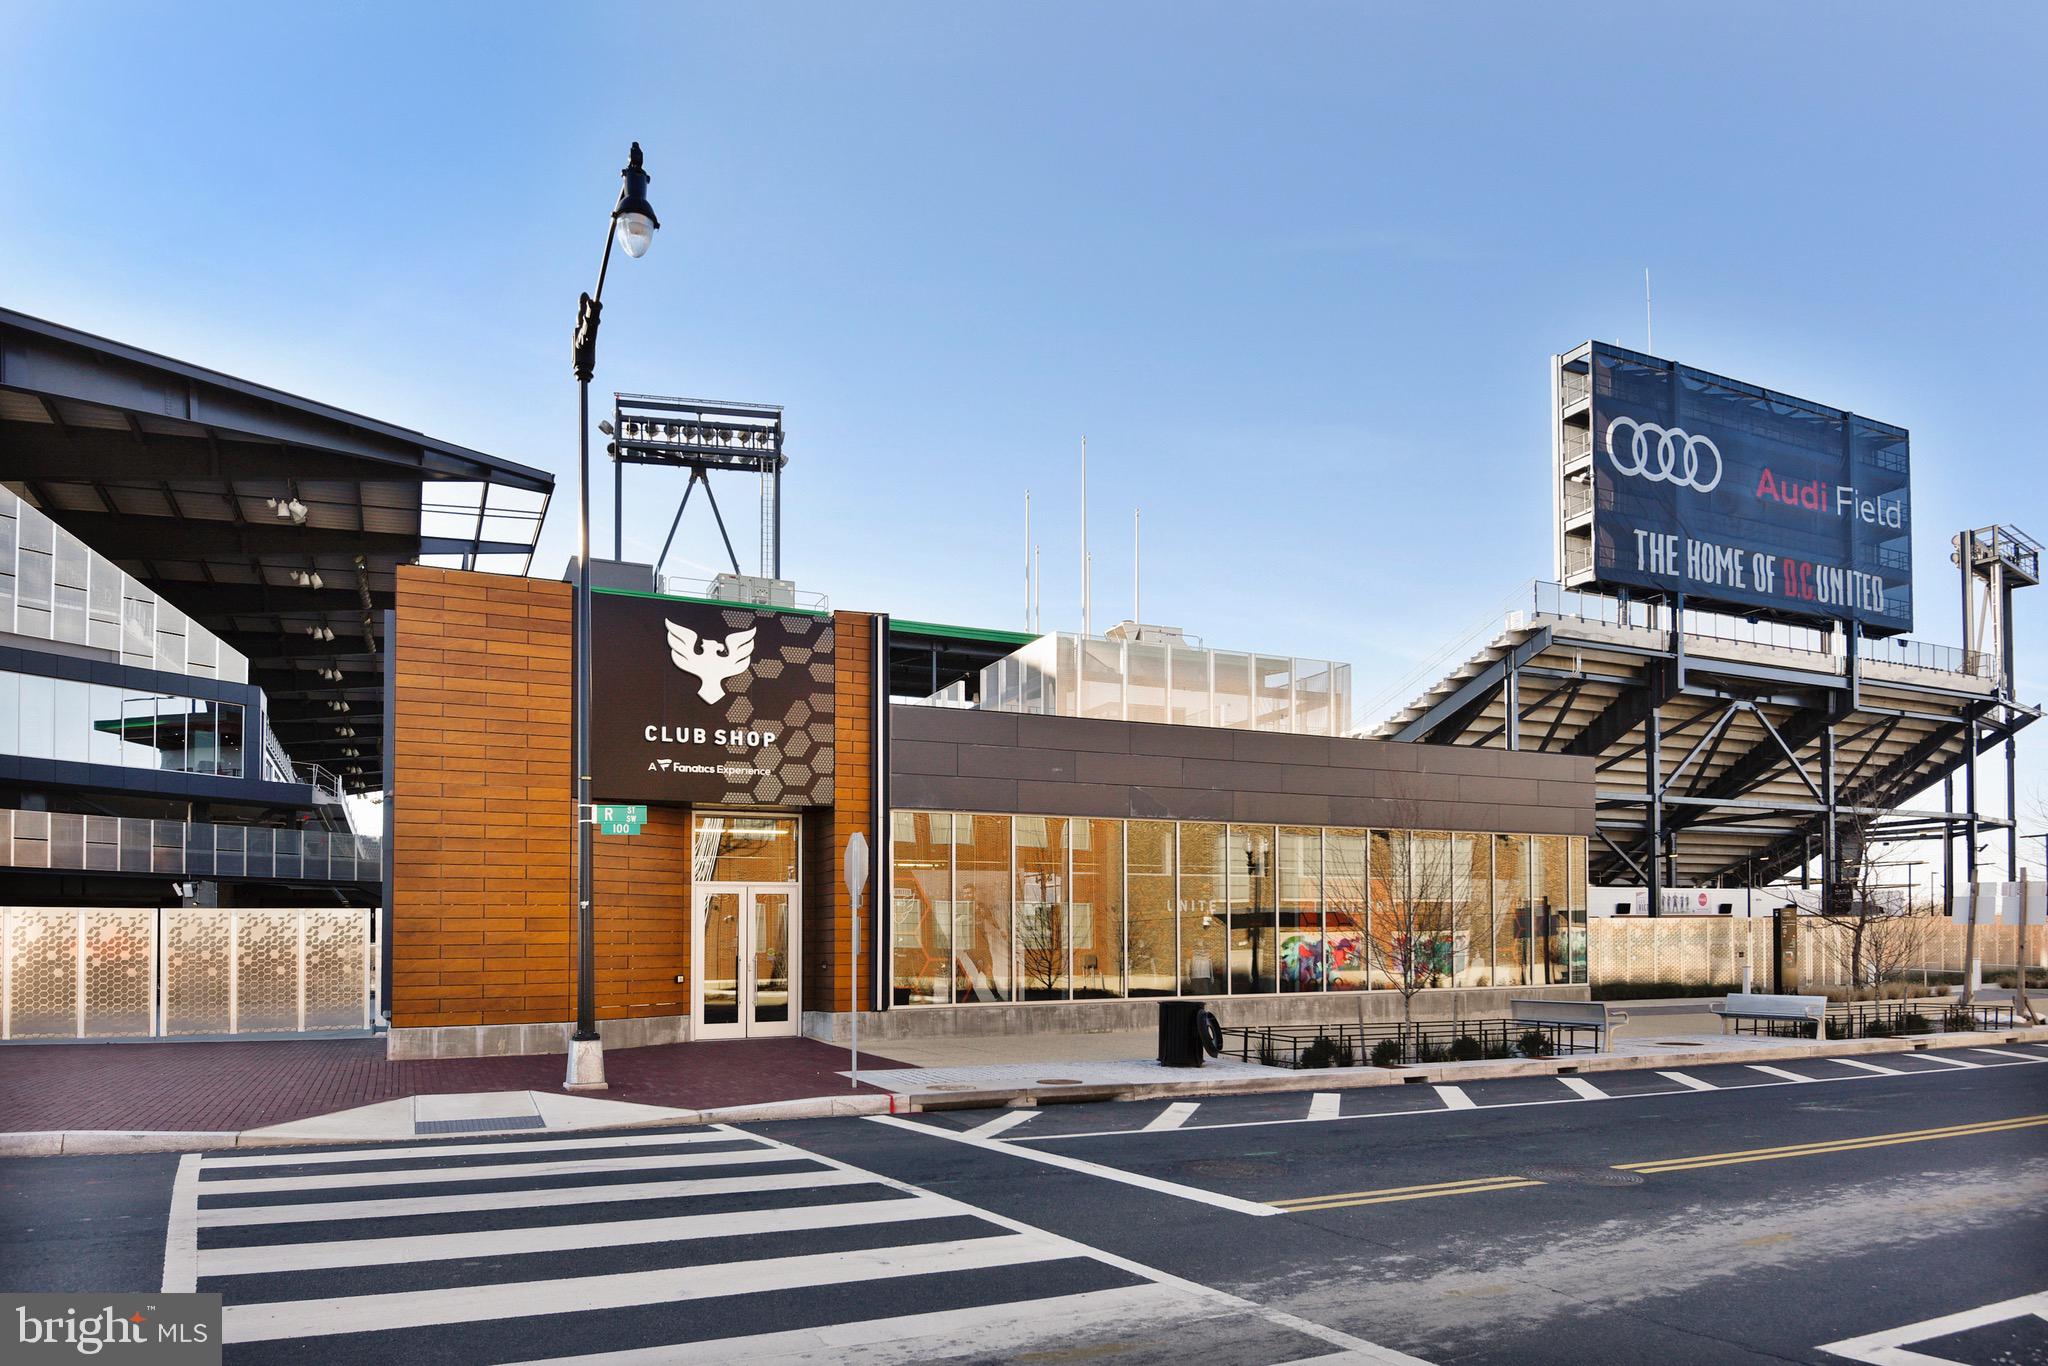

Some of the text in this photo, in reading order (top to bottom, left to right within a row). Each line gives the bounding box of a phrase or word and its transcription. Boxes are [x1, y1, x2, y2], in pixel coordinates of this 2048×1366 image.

[1756, 467, 1902, 529] Audi Field
[1633, 528, 1680, 576] THE
[1687, 538, 1746, 589] HOME
[1752, 552, 1776, 593] OF
[1816, 565, 1884, 612] UNITED
[644, 725, 776, 748] CLUB SHOP
[648, 762, 771, 776] A Fanatics Experience
[604, 806, 636, 821] R ST
[626, 815, 637, 823] SW
[613, 823, 630, 834] 100
